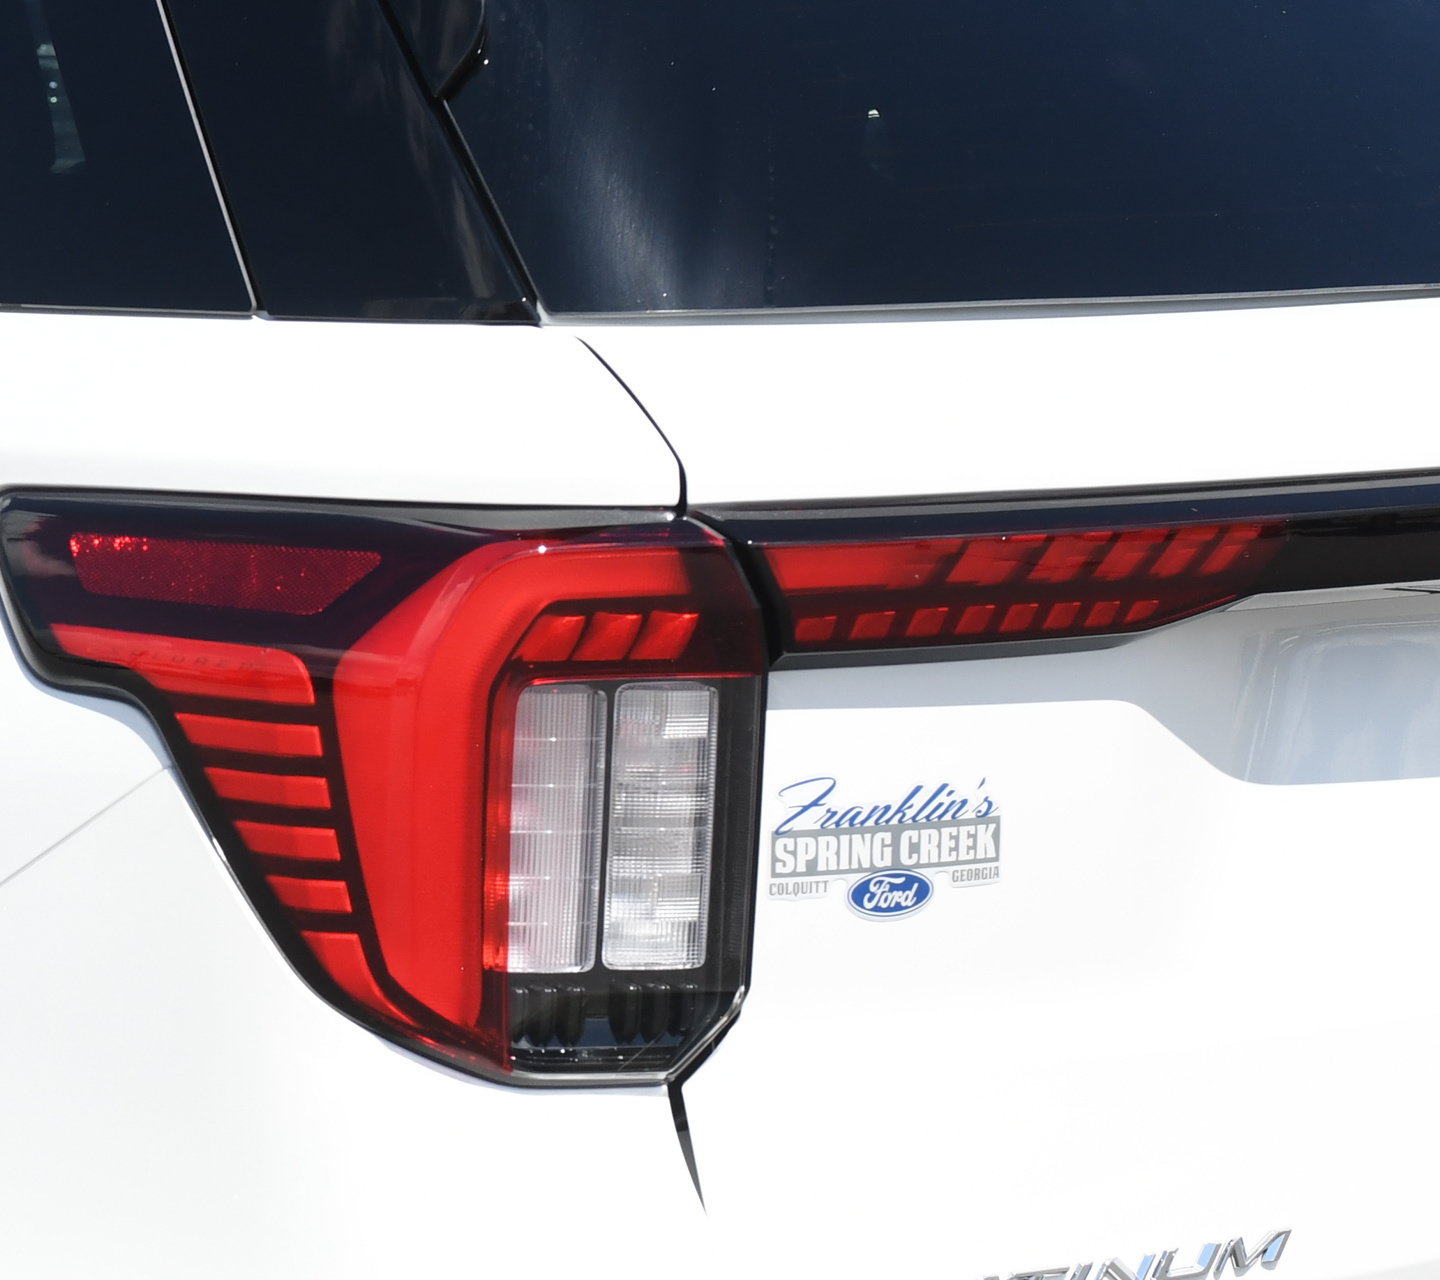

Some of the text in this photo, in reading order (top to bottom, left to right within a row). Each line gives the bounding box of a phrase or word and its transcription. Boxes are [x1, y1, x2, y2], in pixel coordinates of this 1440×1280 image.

[774, 776, 1001, 837] Franklin's
[774, 823, 997, 873] SPRING CREEK
[769, 880, 830, 898] COLQUITT
[951, 865, 1001, 884] GEORGIA
[863, 876, 919, 909] Ford
